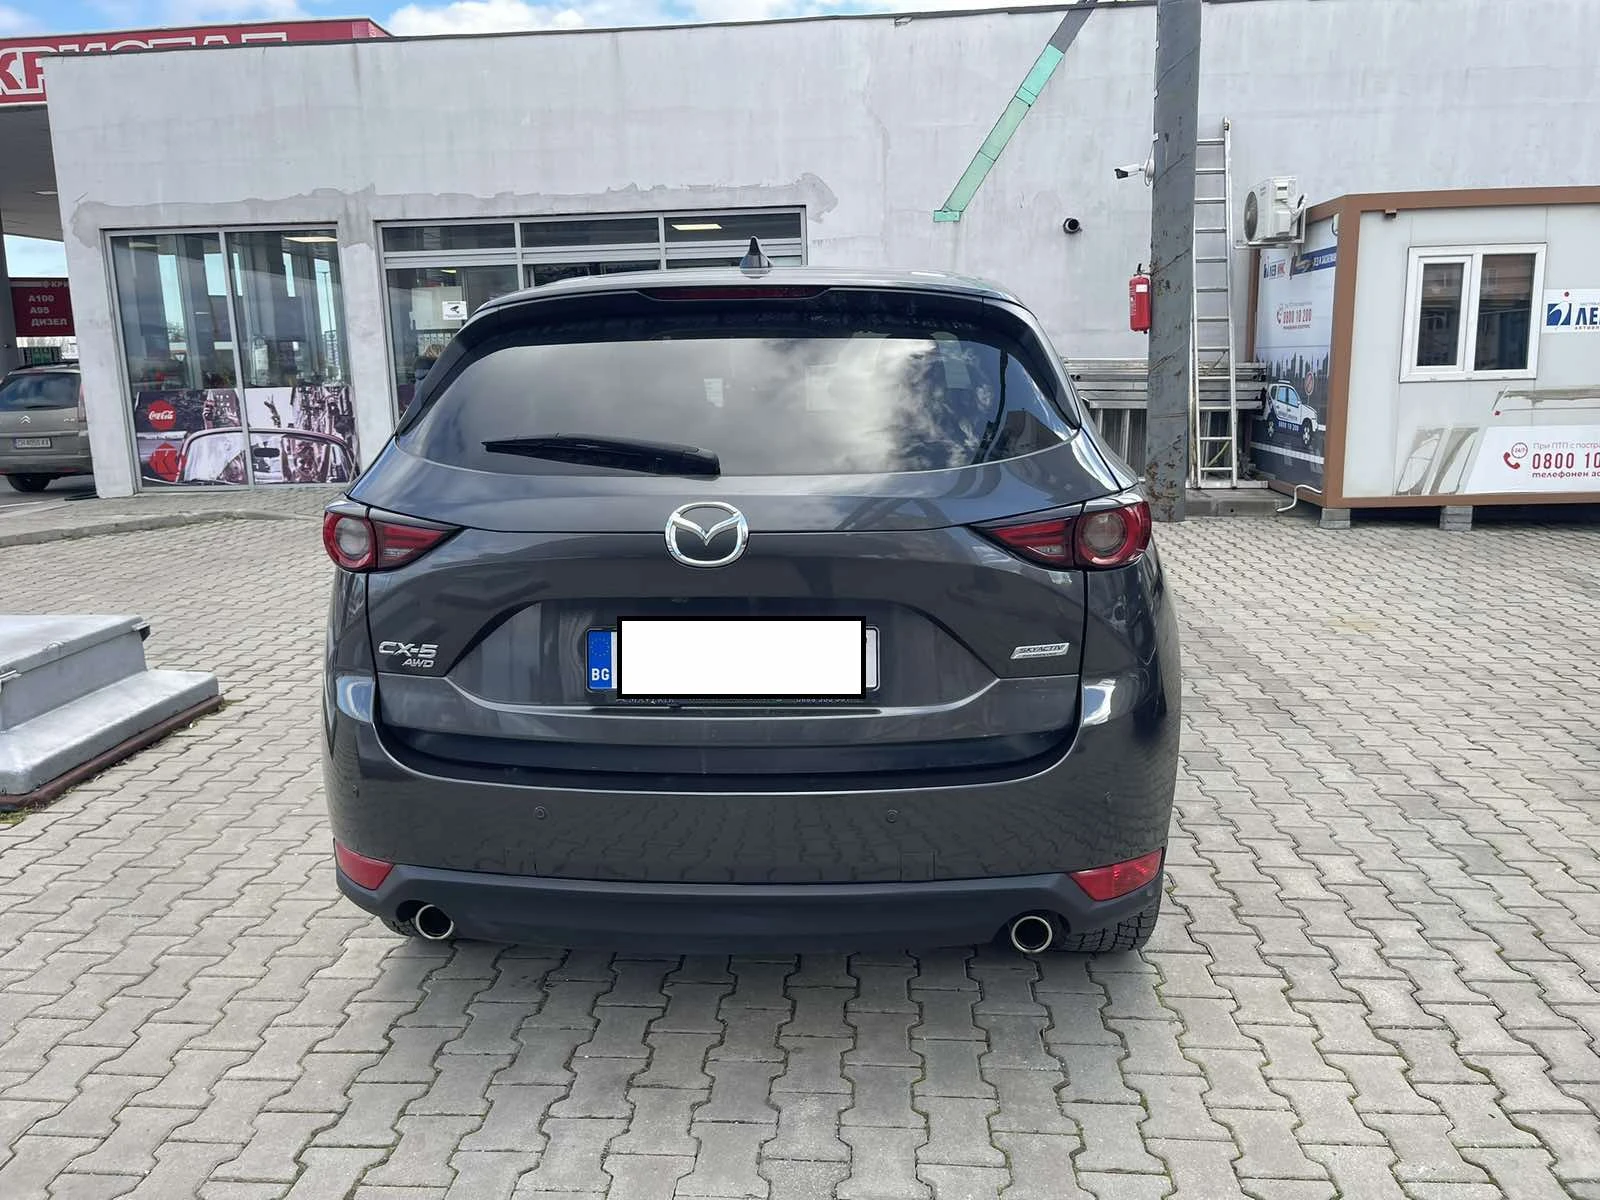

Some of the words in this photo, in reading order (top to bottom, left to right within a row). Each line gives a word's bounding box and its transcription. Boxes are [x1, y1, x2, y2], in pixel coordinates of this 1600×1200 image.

[31, 318, 68, 327] ДИЗЕЛ
[1575, 307, 1600, 326] ЛЕ
[1532, 452, 1574, 469] 0800
[379, 641, 439, 658] CX-5
[402, 659, 434, 667] AWD
[591, 668, 610, 681] BG
